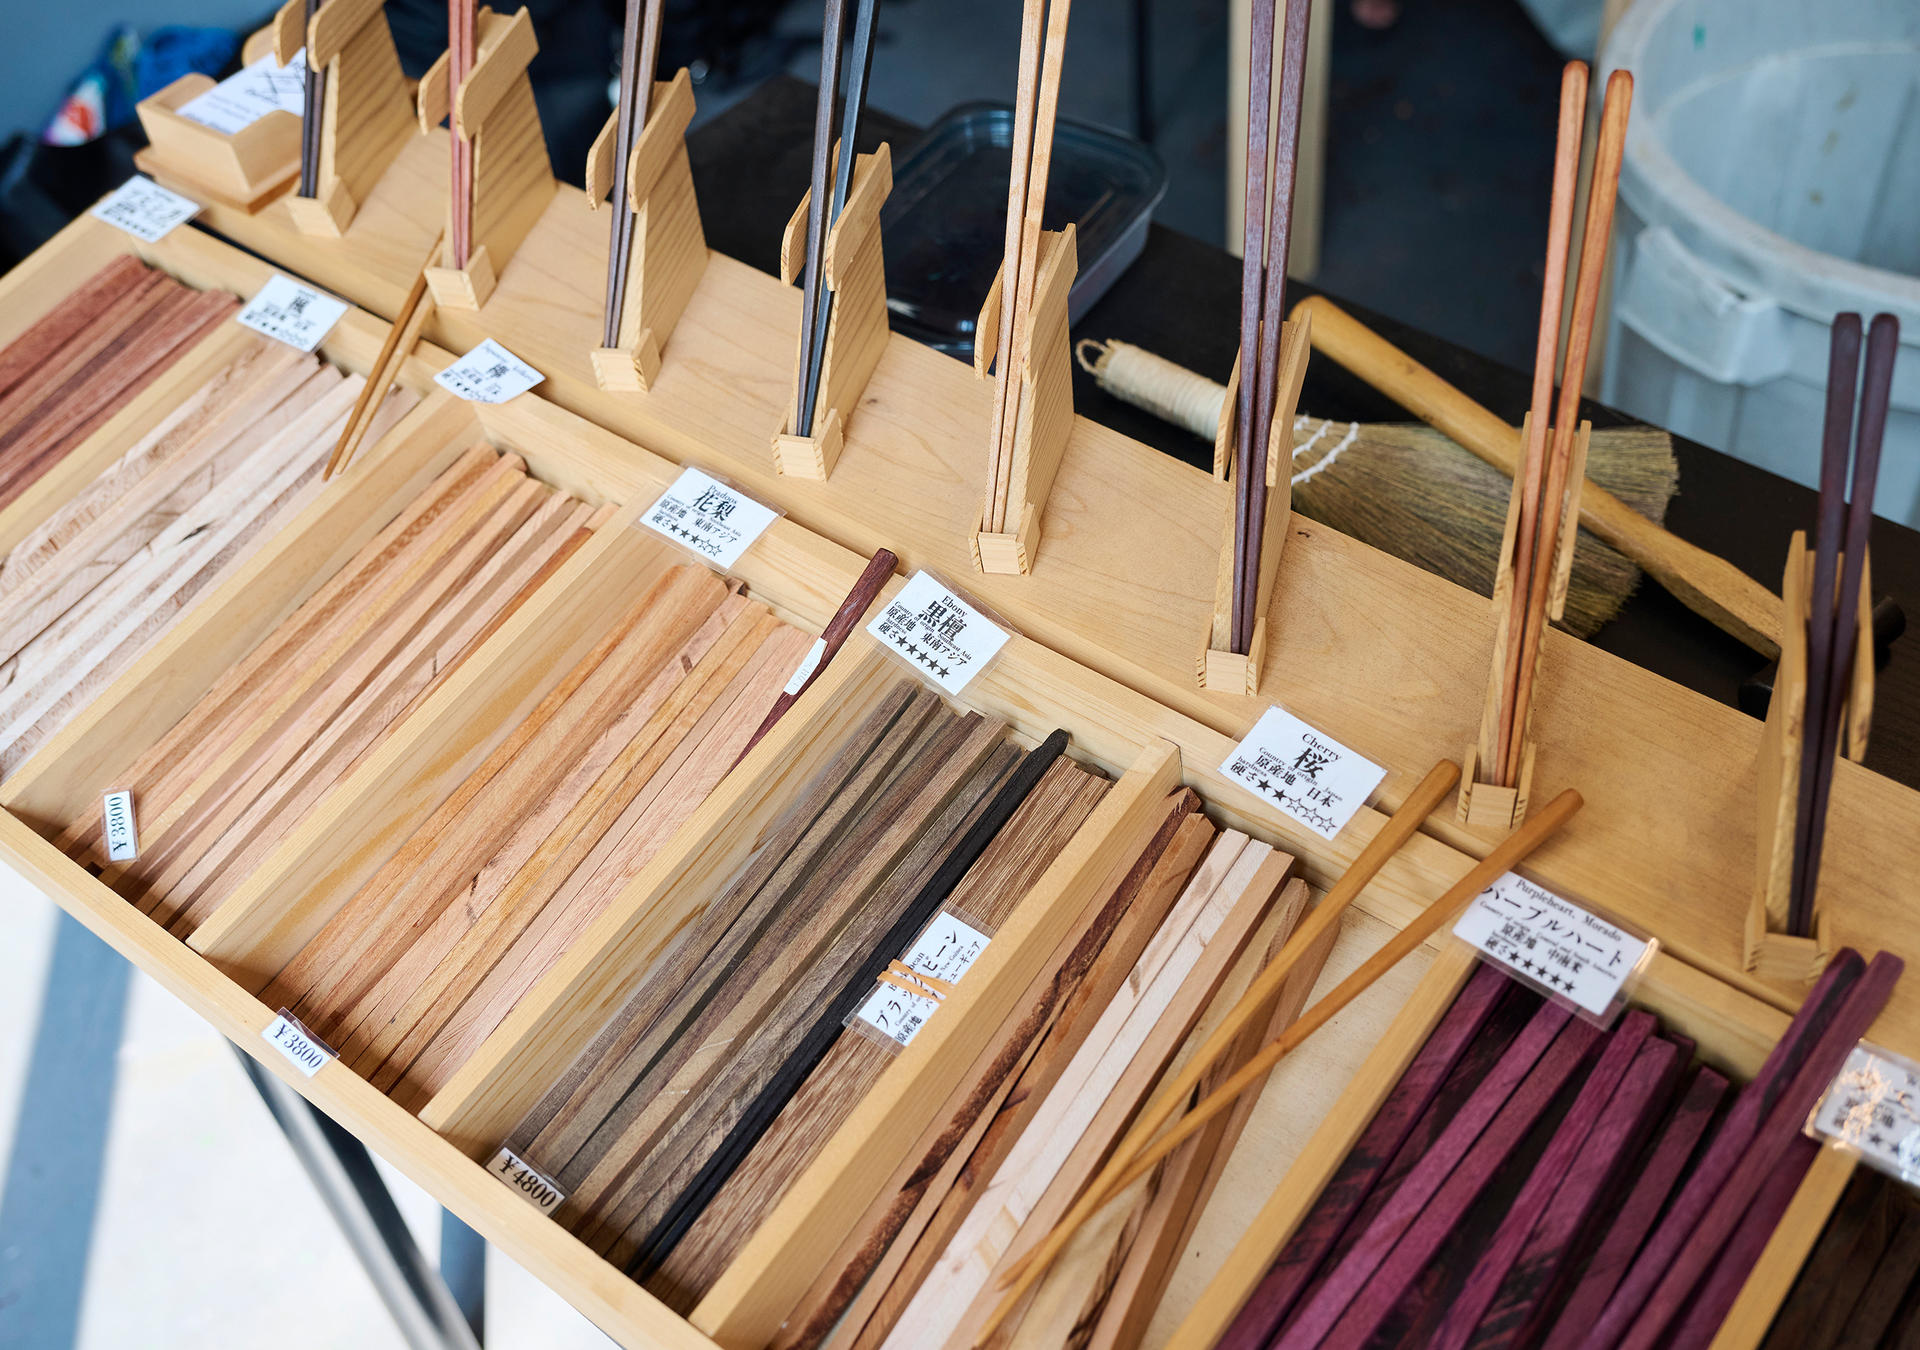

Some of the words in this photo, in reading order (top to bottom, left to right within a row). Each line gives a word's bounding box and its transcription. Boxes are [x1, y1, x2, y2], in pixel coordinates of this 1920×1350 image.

[693, 489, 736, 521] 花梨
[694, 518, 738, 543] 東南アジア
[918, 600, 968, 642] 黒檀
[941, 595, 968, 619] Ebony
[878, 621, 900, 640] 硬さ
[886, 606, 917, 632] 原産地
[920, 632, 968, 666] 東南アジア
[894, 601, 913, 617] Country
[960, 651, 972, 661] Asia
[1294, 747, 1330, 779] 桜
[1301, 733, 1342, 763] Cherry
[1230, 761, 1258, 782] 硬さ
[1237, 755, 1268, 778] hardness
[1255, 754, 1297, 786] 原産地
[1306, 787, 1335, 808] 日本
[1259, 746, 1286, 766] Country
[1296, 770, 1319, 787] origin
[1481, 886, 1621, 967] パープルハート
[1582, 914, 1622, 942] Morado
[1501, 922, 1538, 951] 原産地
[1548, 947, 1583, 974] 中南米
[895, 1015, 923, 1043] 原産地
[273, 1023, 324, 1069] ¥3800
[499, 1154, 557, 1208] ¥4800
